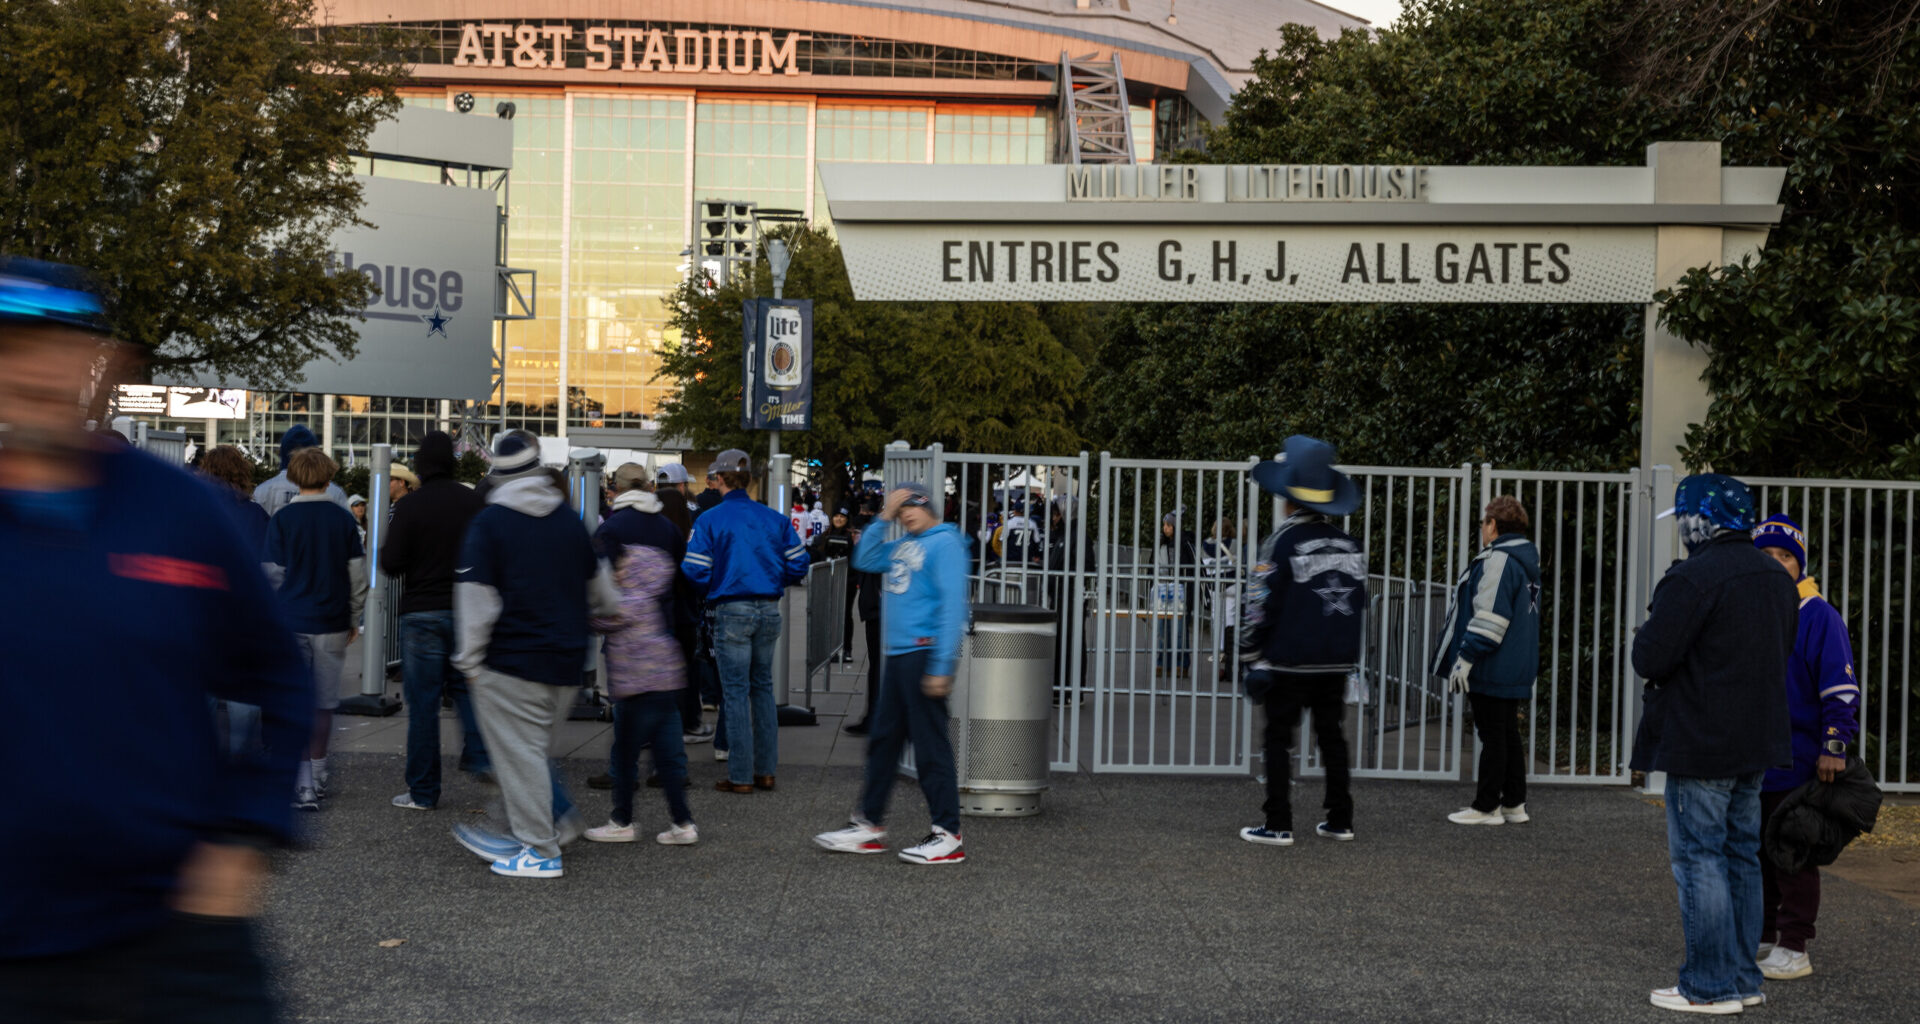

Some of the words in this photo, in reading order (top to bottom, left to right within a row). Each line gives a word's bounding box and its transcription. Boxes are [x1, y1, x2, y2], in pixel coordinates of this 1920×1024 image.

[454, 23, 572, 69] AT&T
[585, 27, 800, 75] STADIUM
[1066, 165, 1199, 201] MILLER
[1225, 165, 1429, 202] LITEHOUSE
[942, 241, 1120, 283] ENTRIES
[1157, 240, 1197, 286] G,
[1211, 240, 1251, 286] H,
[1265, 240, 1300, 286] J,
[1341, 242, 1421, 284] ALL
[1434, 242, 1571, 285] GATES
[769, 315, 799, 340] Lite
[760, 401, 805, 422] Miller
[780, 414, 805, 425] TIME
